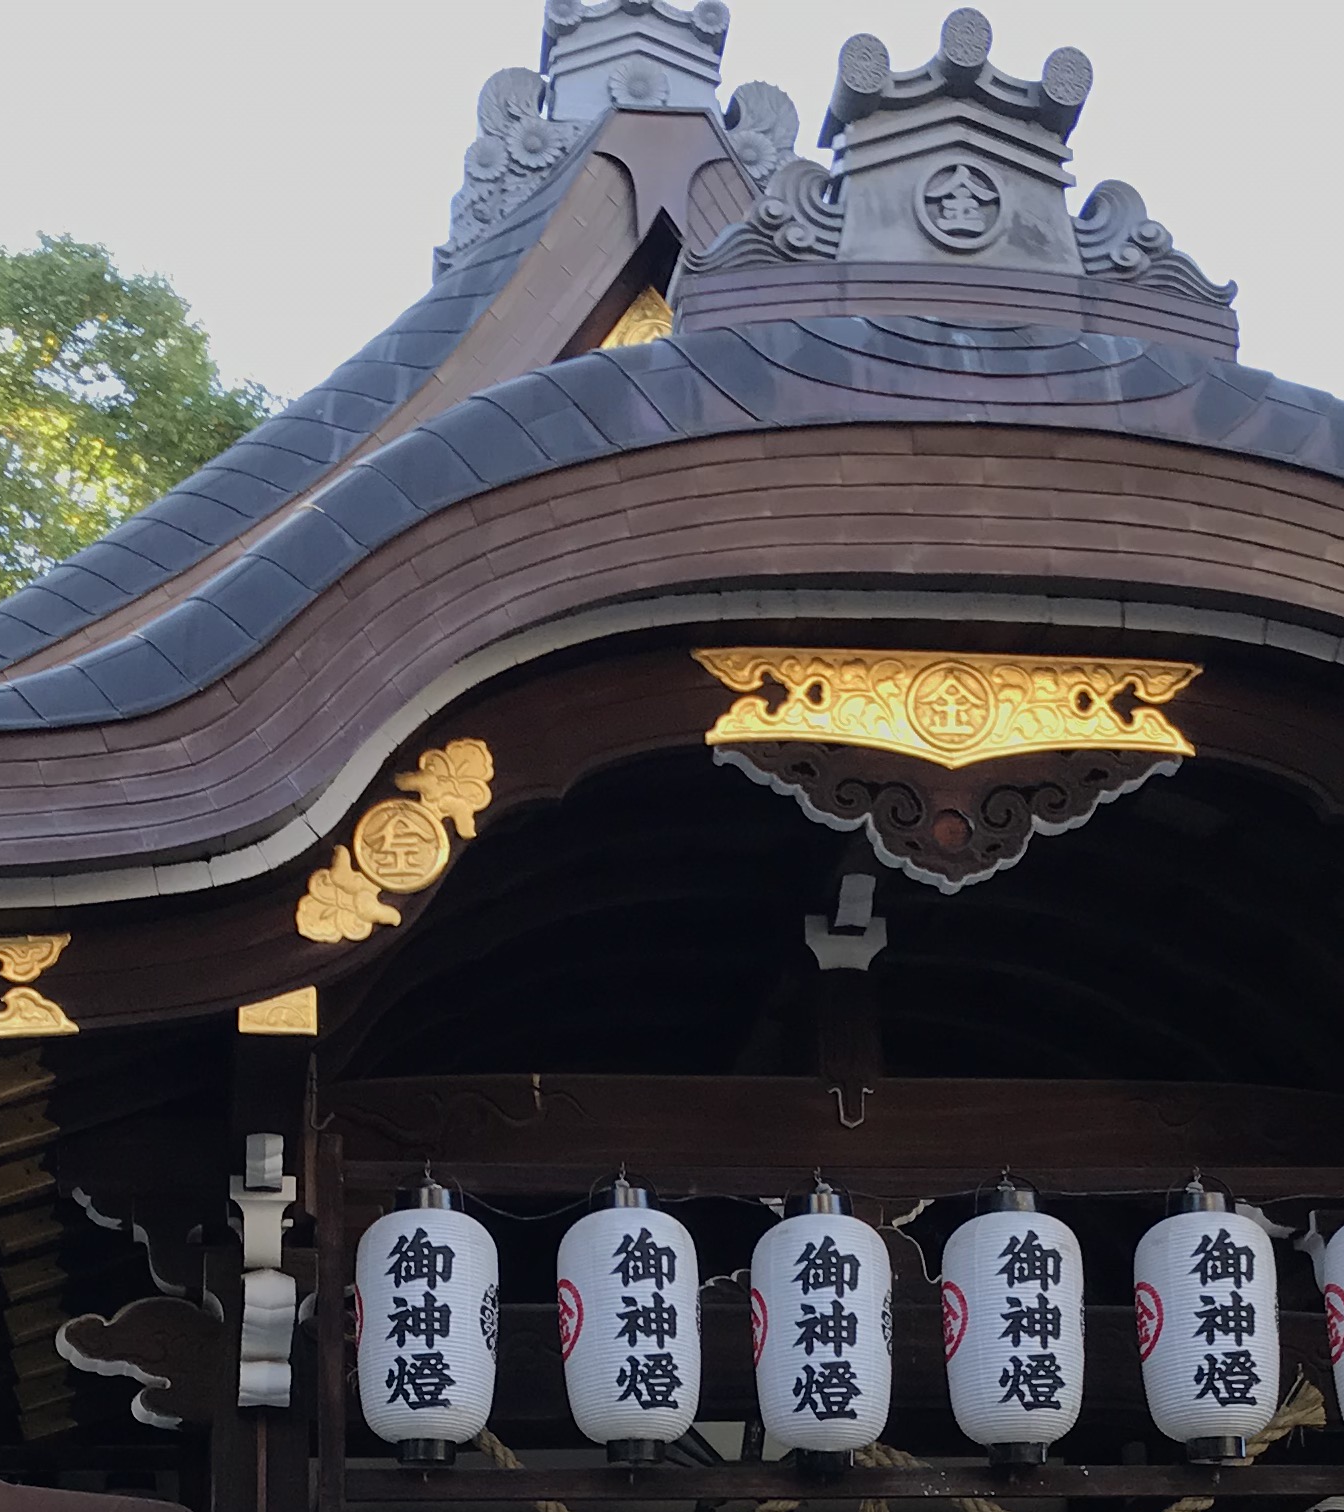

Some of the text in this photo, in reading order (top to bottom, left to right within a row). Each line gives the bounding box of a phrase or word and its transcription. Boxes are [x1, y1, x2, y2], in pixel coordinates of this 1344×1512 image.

[925, 164, 1000, 231] 金
[922, 670, 986, 734] 金
[363, 814, 435, 876] 金
[384, 1227, 455, 1410] 御神燈
[610, 1227, 682, 1411] 御神燈
[792, 1236, 863, 1422] 御神燈
[996, 1229, 1067, 1412] 御神燈
[1188, 1228, 1261, 1408] 御神燈
